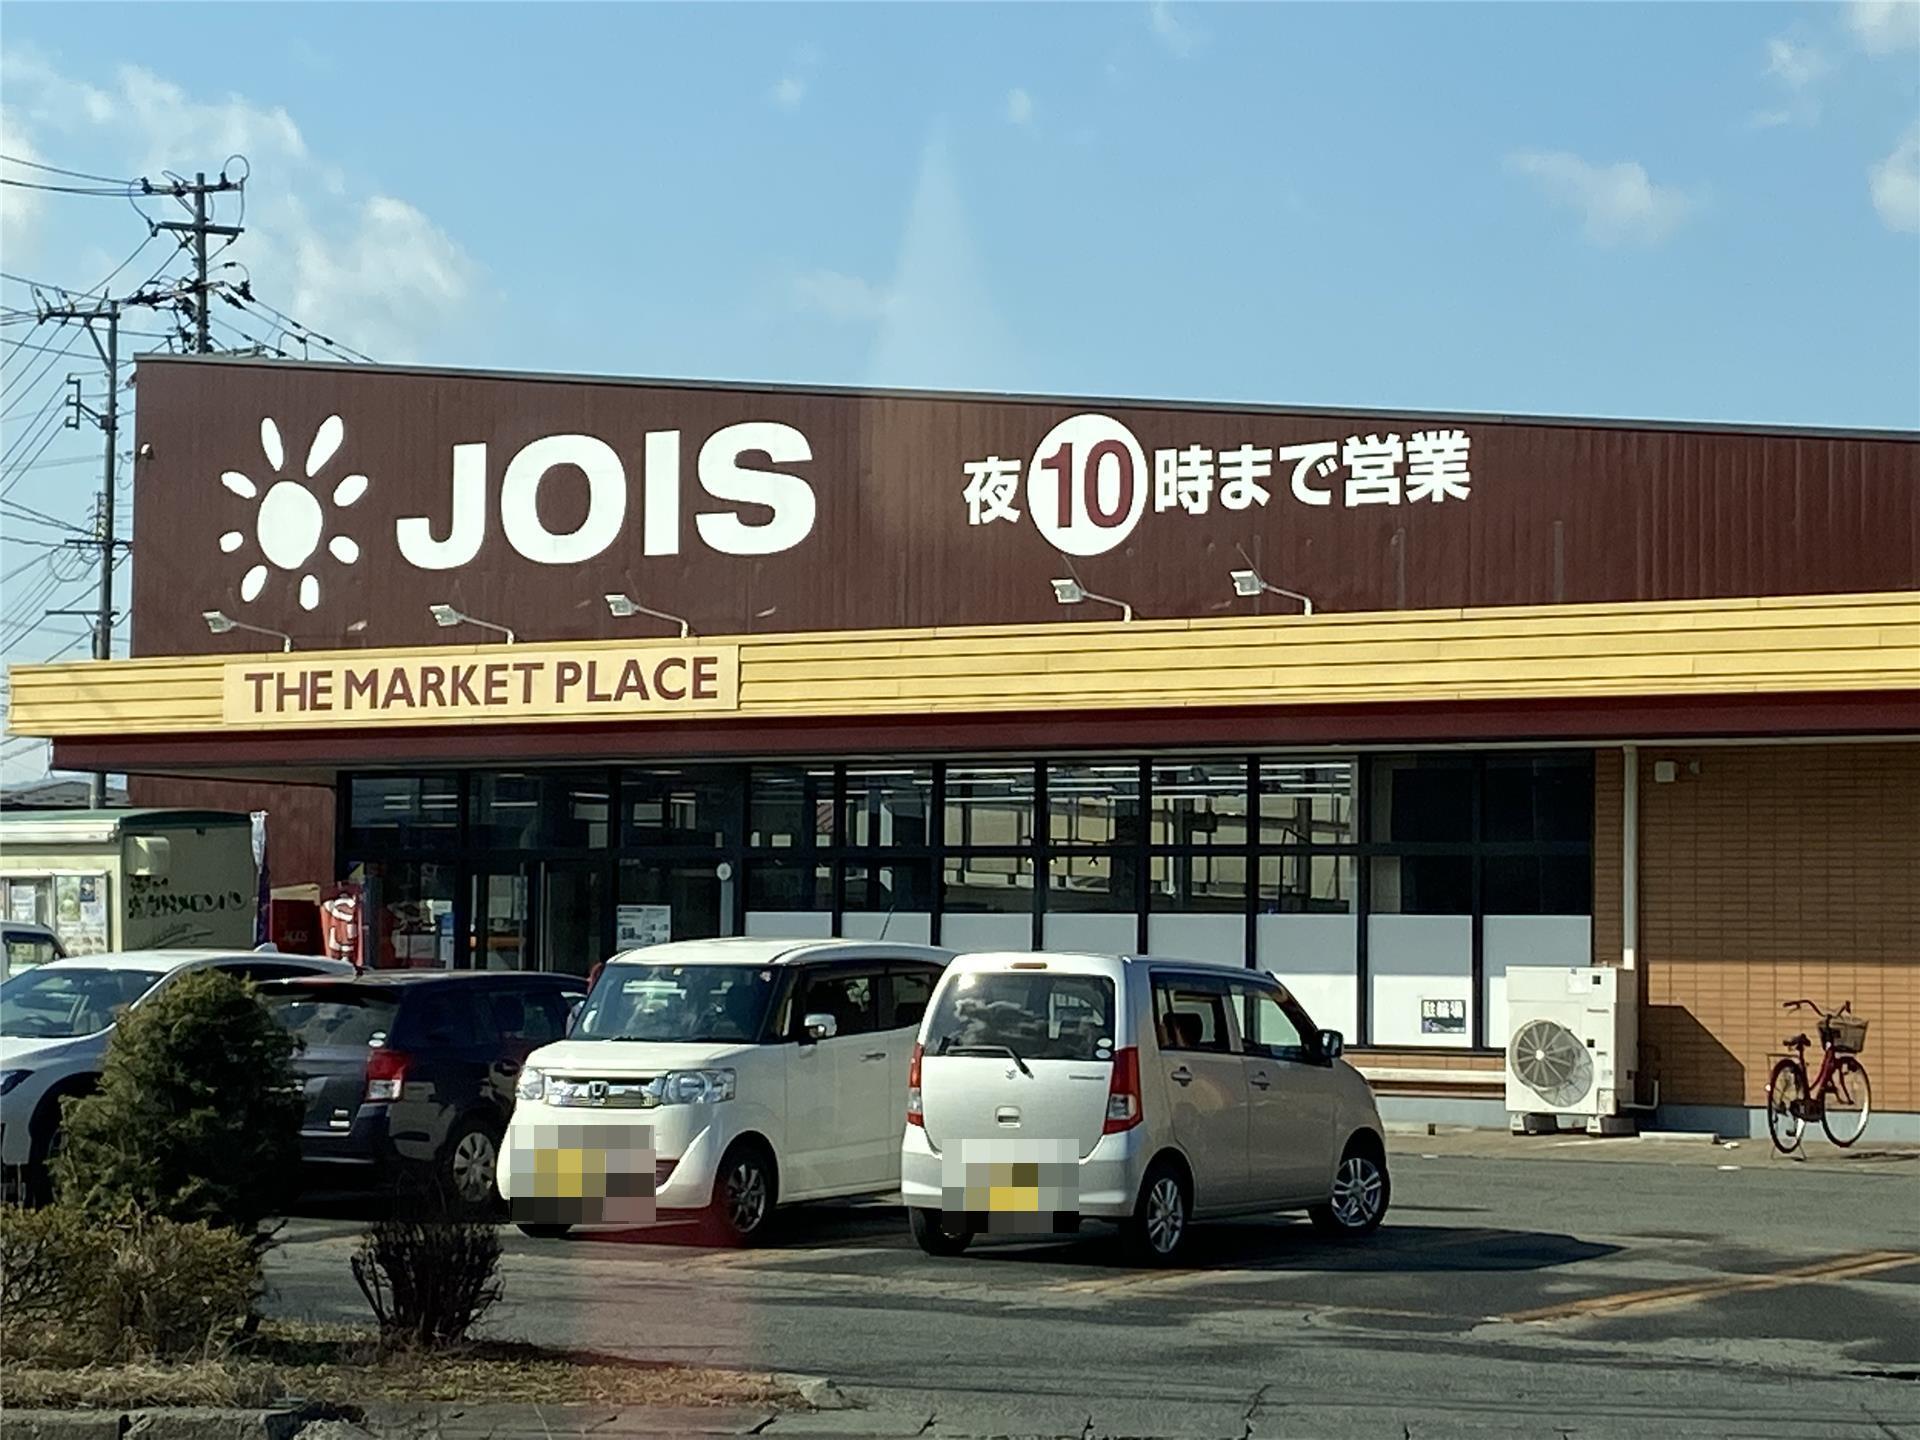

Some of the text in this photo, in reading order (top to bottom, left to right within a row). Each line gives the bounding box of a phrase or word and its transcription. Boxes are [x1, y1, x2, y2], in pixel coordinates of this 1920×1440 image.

[396, 422, 816, 570] JOIS
[244, 656, 718, 713] THE MARKET PLACE
